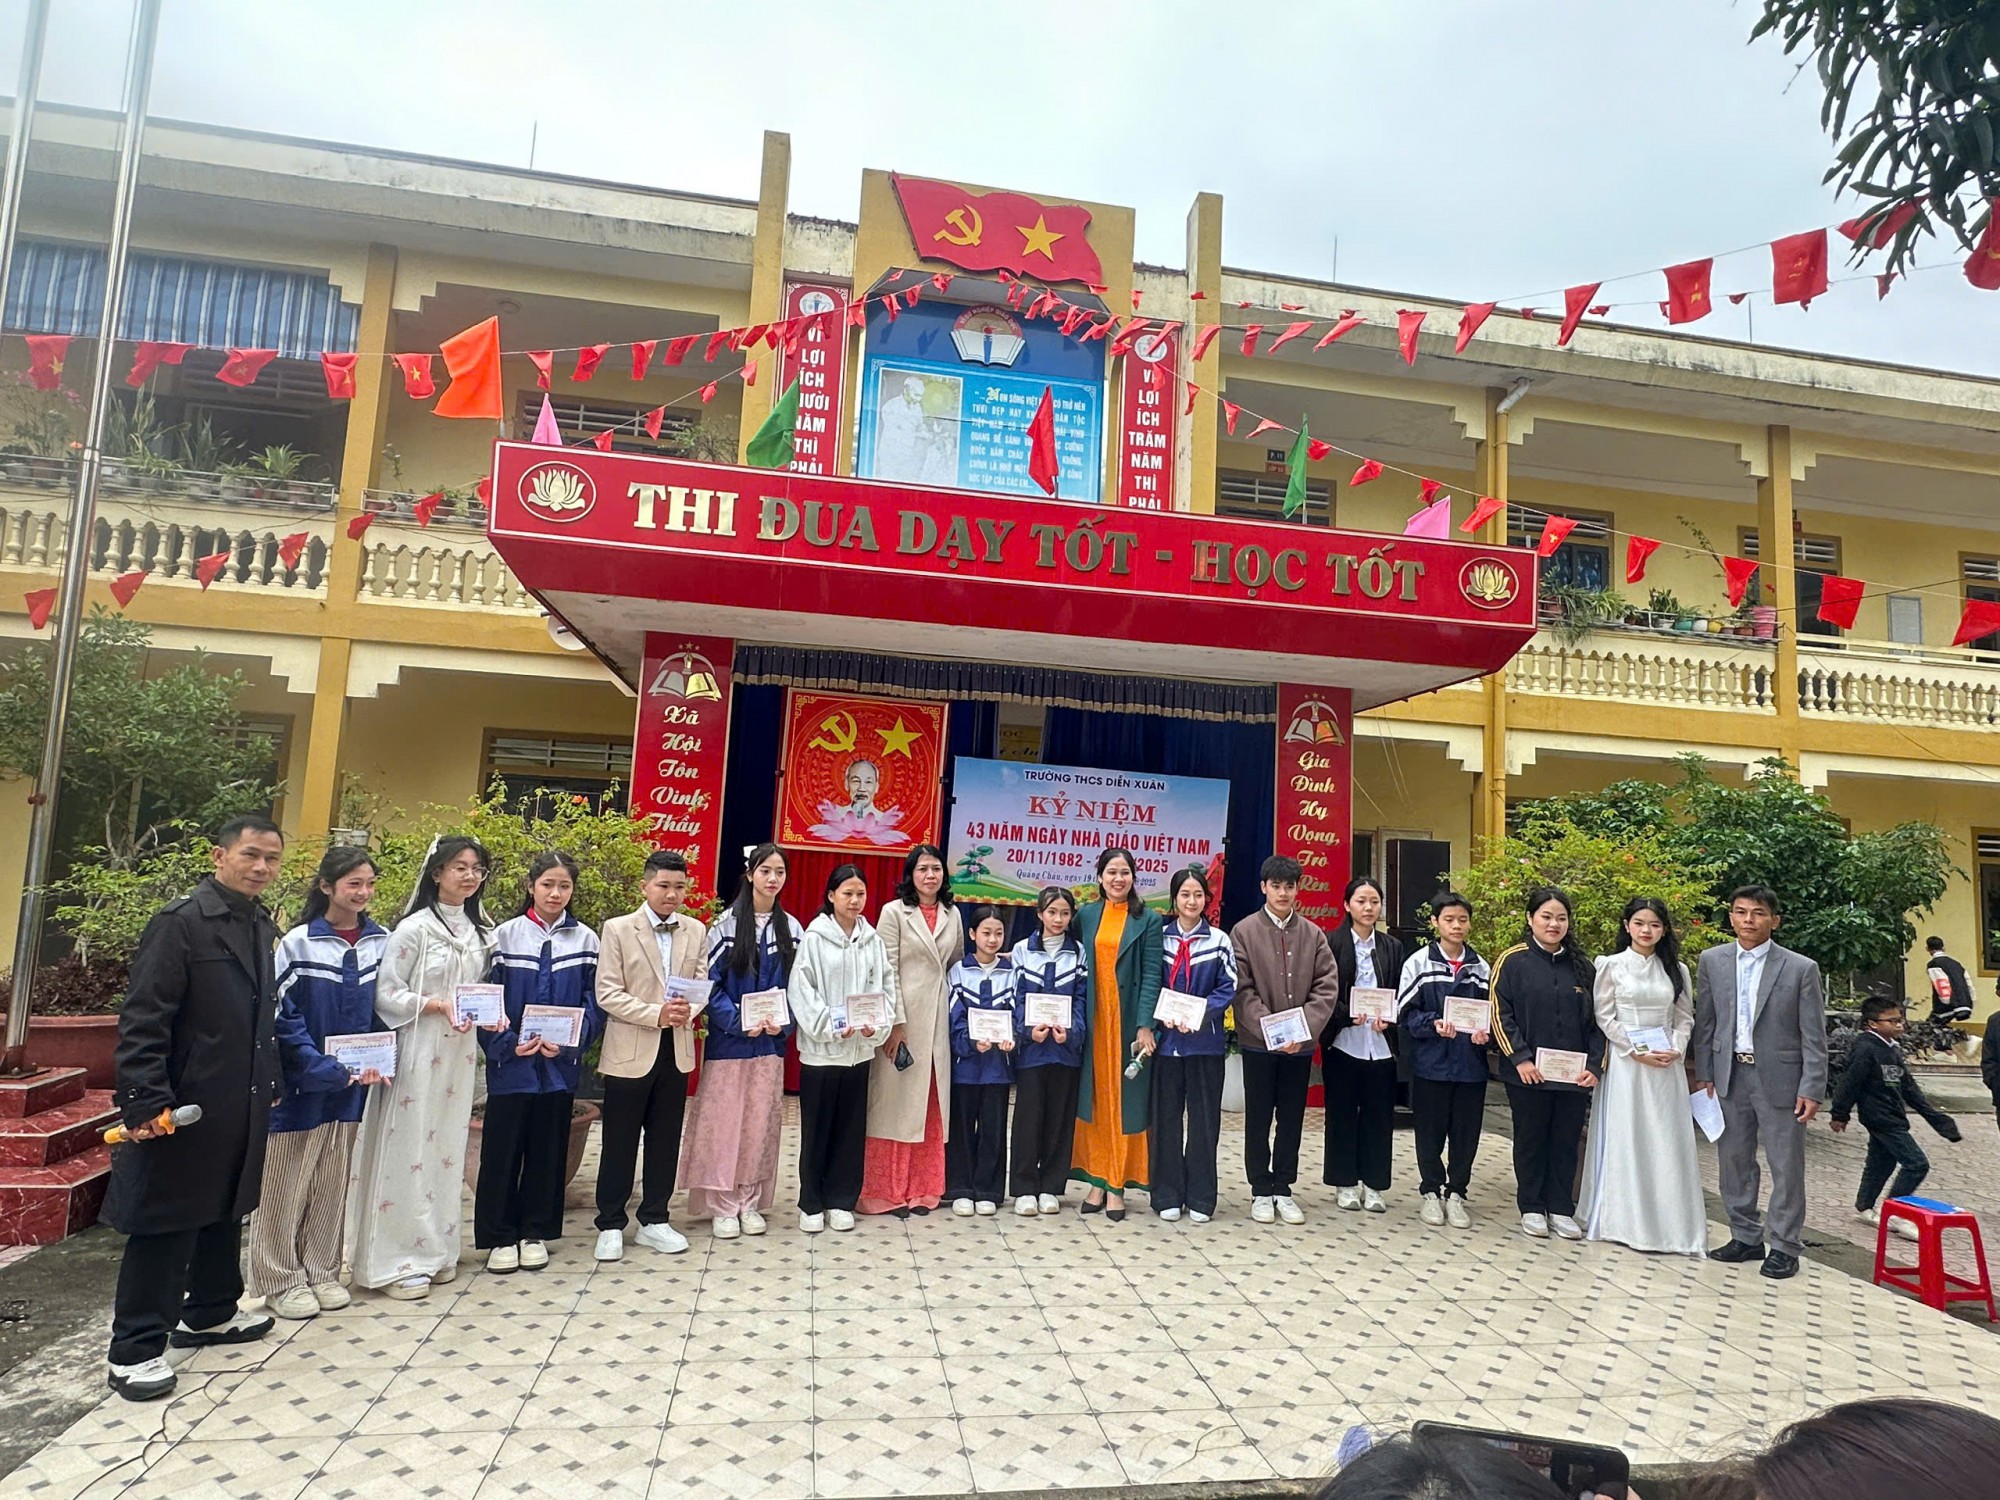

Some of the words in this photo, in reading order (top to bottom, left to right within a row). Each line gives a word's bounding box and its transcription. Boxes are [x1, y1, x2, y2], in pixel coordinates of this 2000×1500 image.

[801, 348, 826, 368] LỢI
[799, 367, 825, 388] ÍCH
[1136, 408, 1160, 427] ÍCH
[794, 436, 819, 455] THÌ
[1128, 430, 1167, 449] TRĂM
[1131, 450, 1163, 470] NĂM
[1134, 473, 1157, 492] THÌ
[627, 481, 739, 537] THI
[756, 496, 880, 551] ĐUA
[896, 510, 1016, 569] DẠY
[1030, 514, 1139, 575] TỐT
[1155, 549, 1173, 561] -
[1191, 540, 1308, 597] HỌC
[1326, 543, 1426, 601] TỐT
[663, 705, 700, 726] Xã
[661, 732, 703, 756] Hội
[658, 758, 700, 779] Tôn
[1297, 750, 1331, 771] Gia
[1025, 770, 1072, 783] TRƯỜNG
[1075, 774, 1103, 786] THCS
[1105, 774, 1132, 788] DIỄN
[1134, 779, 1166, 791] XUÂN
[1290, 774, 1336, 794] Đình
[1028, 790, 1070, 816] KỶ
[1076, 797, 1157, 826] NIỆM
[1298, 799, 1329, 820] Hy
[649, 812, 703, 837] Thầy
[1287, 823, 1340, 846] Vọng,
[966, 821, 984, 839] 43
[988, 820, 1024, 842] NĂM
[1027, 824, 1068, 845] NGÀY
[1071, 828, 1101, 848] NHÀ
[1106, 830, 1138, 851] GIÁO
[1143, 832, 1175, 856] VIỆT
[1177, 838, 1211, 856] NAM
[1006, 848, 1083, 867] 20/11/1982
[1296, 849, 1329, 869] Trò
[1083, 873, 1092, 883] 19
[1299, 873, 1331, 892] Rèn
